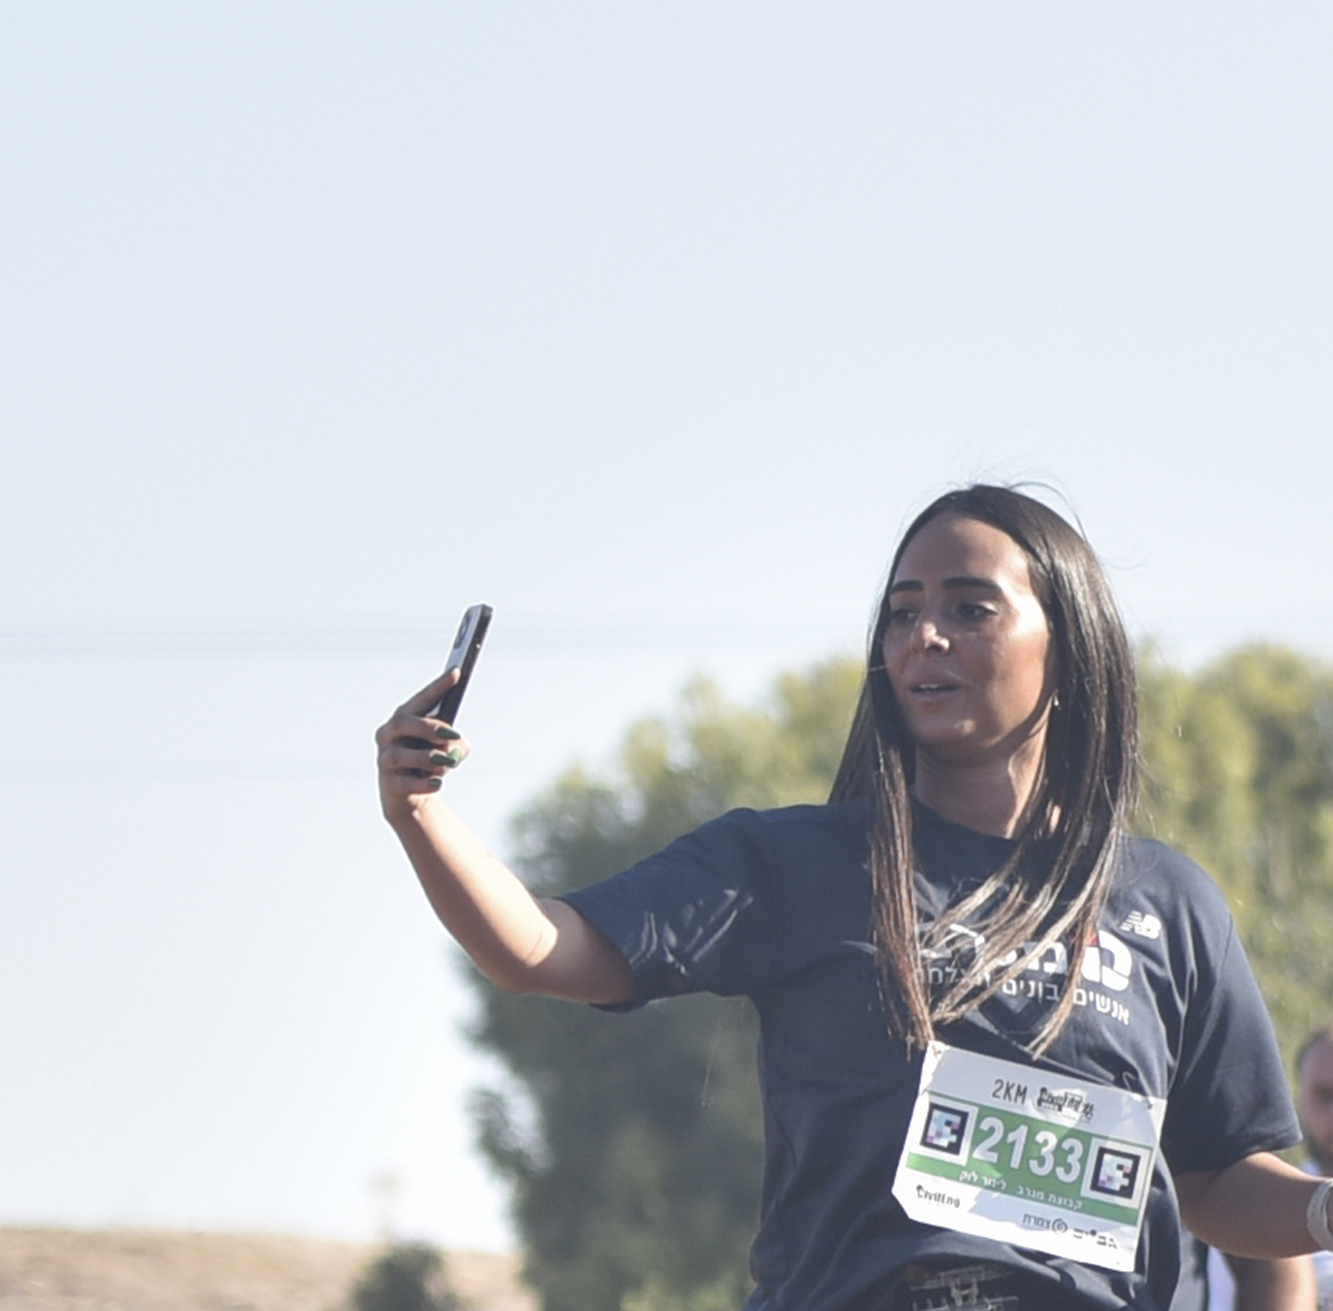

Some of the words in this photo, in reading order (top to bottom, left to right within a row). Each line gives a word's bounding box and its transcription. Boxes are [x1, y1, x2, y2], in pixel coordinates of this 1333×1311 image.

[1001, 977, 1060, 1003] בונים
[1072, 988, 1131, 1026] אנשים
[991, 1078, 1028, 1106] 2KM
[971, 1115, 1085, 1184] 2133
[1047, 1193, 1083, 1211] קבוצת
